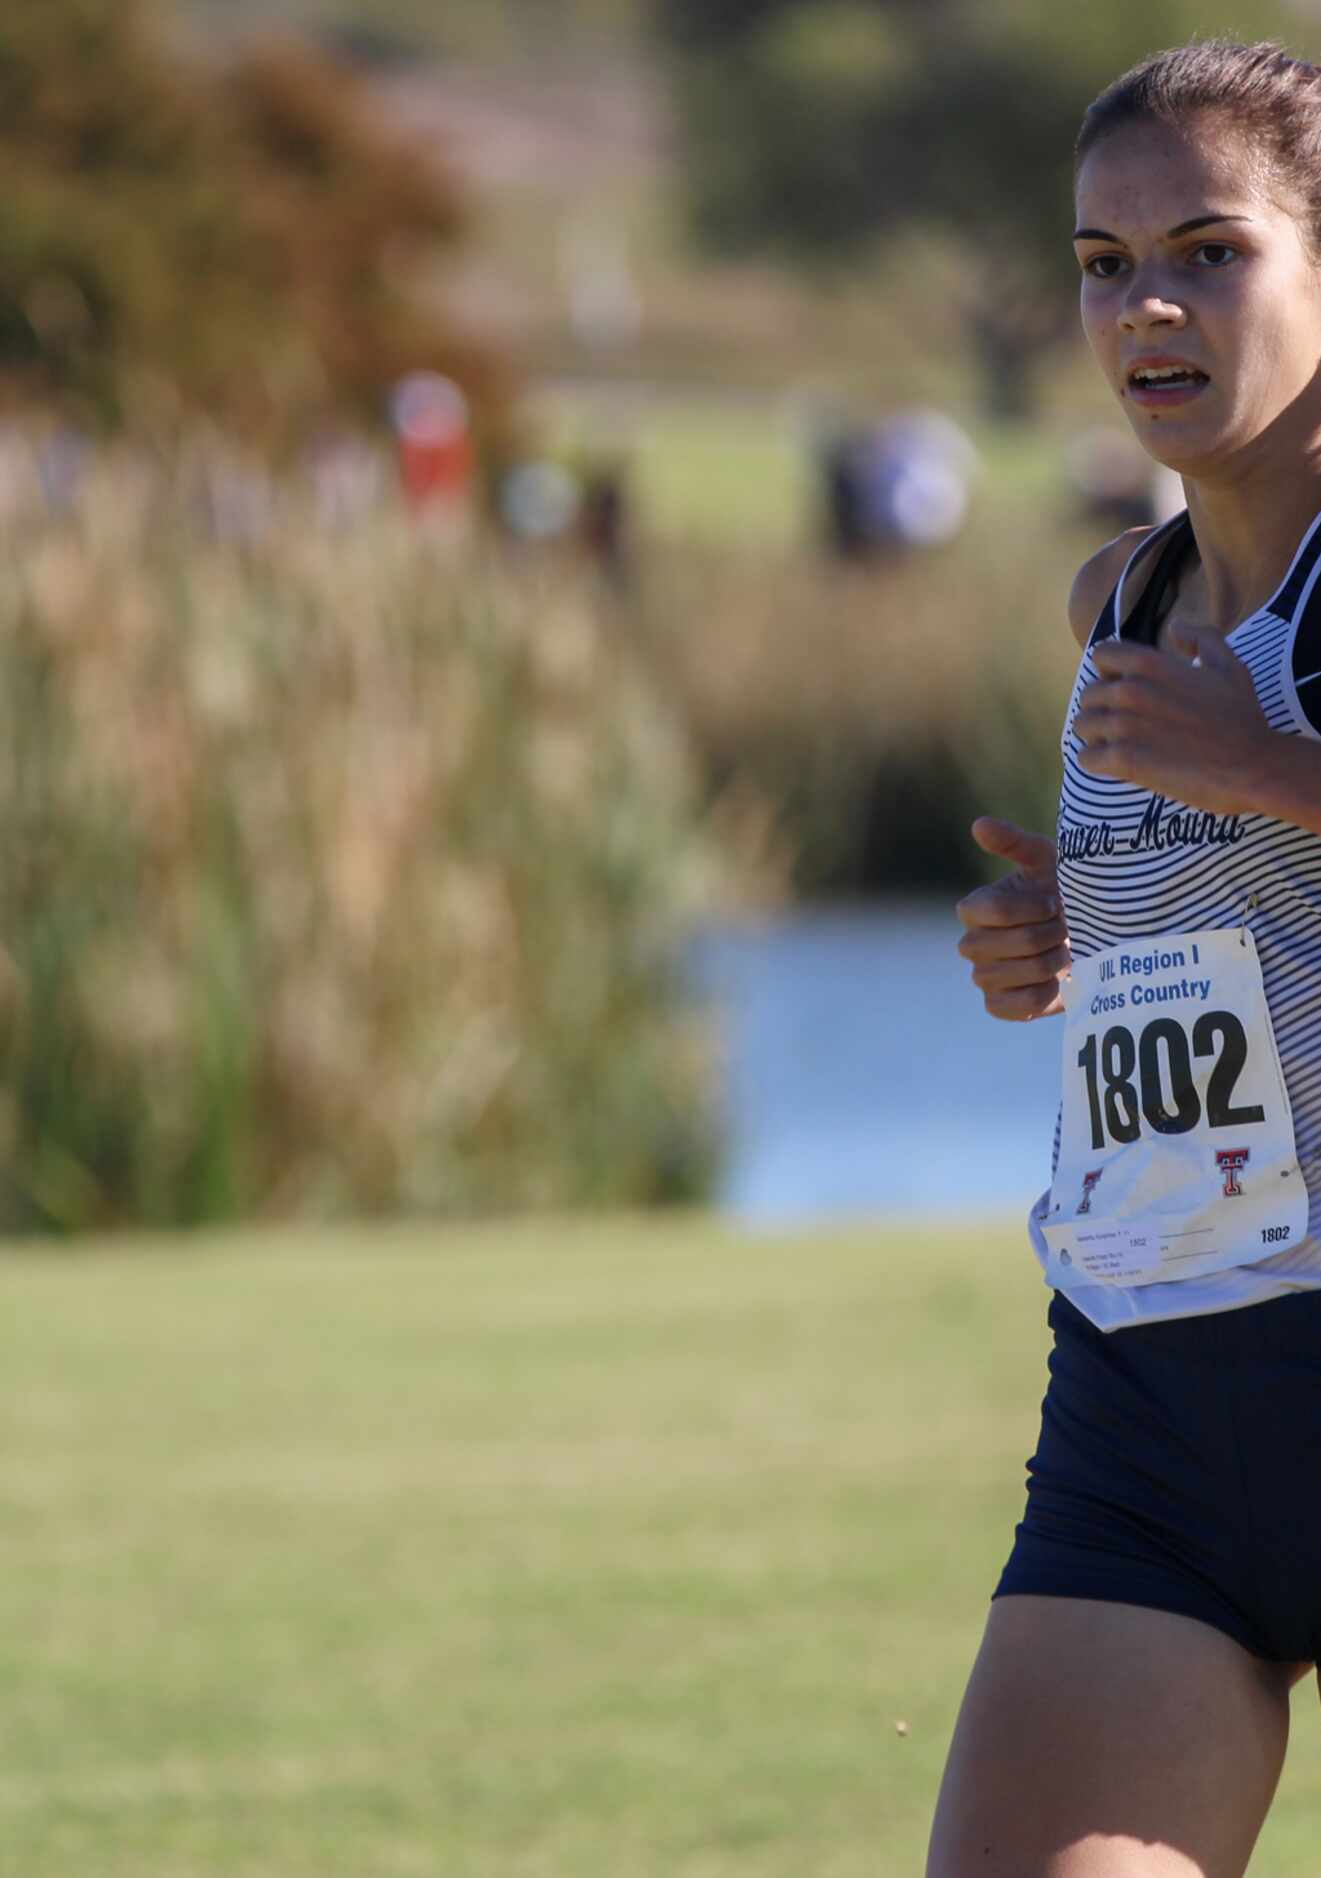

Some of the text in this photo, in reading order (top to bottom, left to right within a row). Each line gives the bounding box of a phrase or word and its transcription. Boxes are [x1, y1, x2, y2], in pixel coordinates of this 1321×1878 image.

[1120, 949, 1185, 976] Region
[1192, 944, 1199, 964] I
[1090, 978, 1211, 1015] Cross Country
[1078, 1010, 1265, 1150] 1802
[1261, 1226, 1291, 1244] 1802
